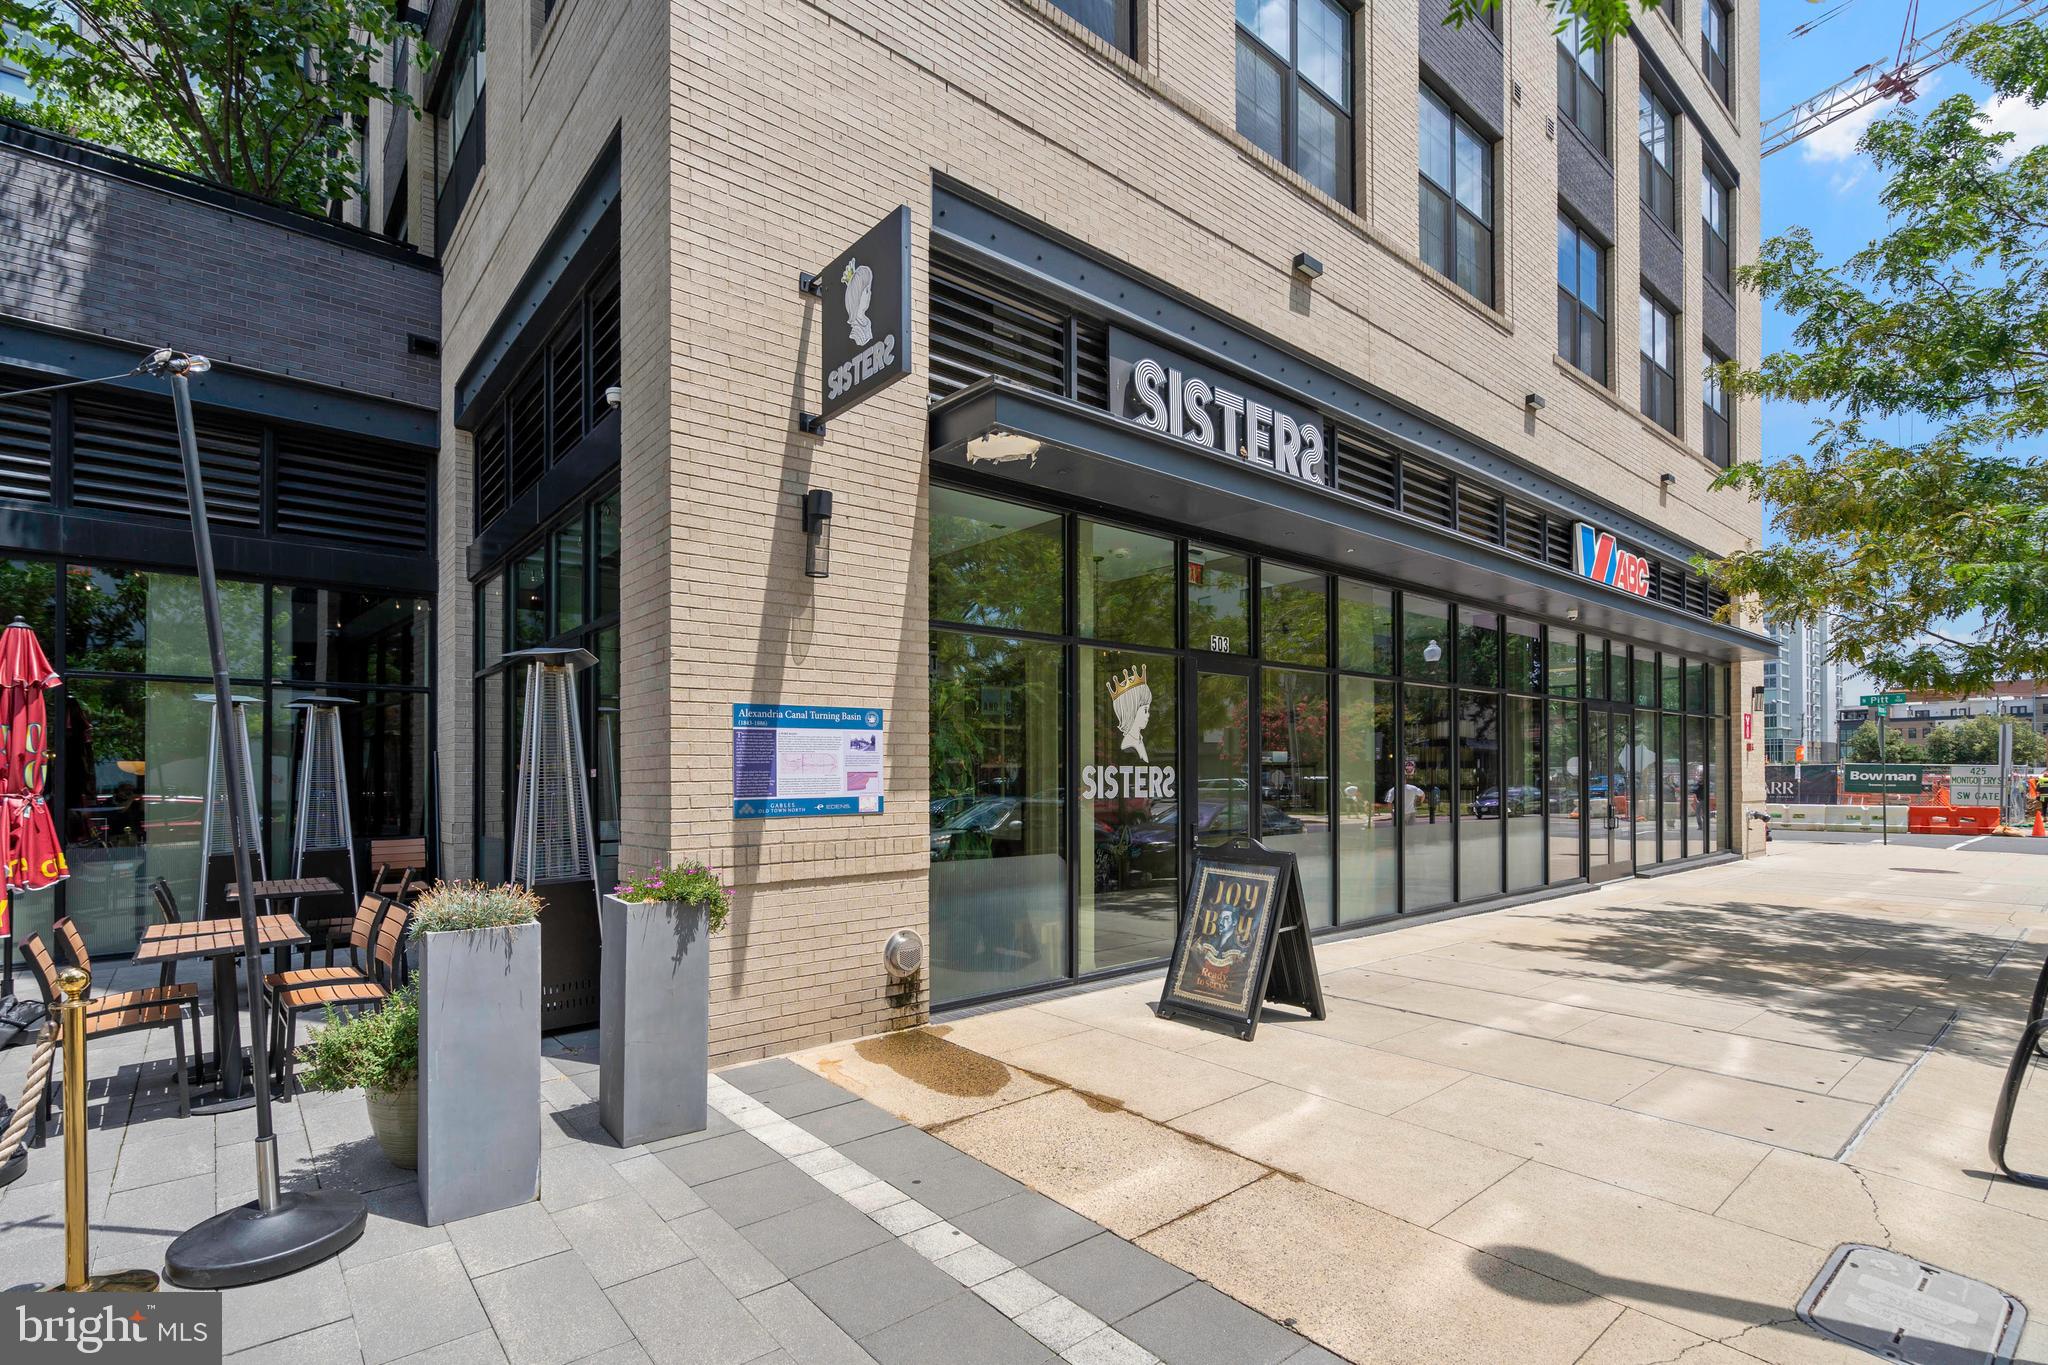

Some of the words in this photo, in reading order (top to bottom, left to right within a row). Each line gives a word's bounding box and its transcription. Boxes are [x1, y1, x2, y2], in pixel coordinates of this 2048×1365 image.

[827, 334, 895, 400] SISTERS
[1133, 359, 1325, 486] SISTERS
[1612, 549, 1650, 598] ABC
[1211, 635, 1229, 651] 503
[1870, 696, 1889, 704] Pitt
[738, 708, 784, 719] Alexandria
[785, 709, 808, 720] Canal
[810, 711, 840, 723] Turning
[841, 713, 862, 721] Basin
[1849, 770, 1917, 782] Bowman
[1970, 767, 1986, 776] 425
[1082, 764, 1176, 800] SISTERS
[1951, 776, 1995, 785] MONTGOERY
[1957, 792, 1970, 800] SW
[1974, 792, 2000, 801] GATE
[1210, 879, 1261, 911] JOY
